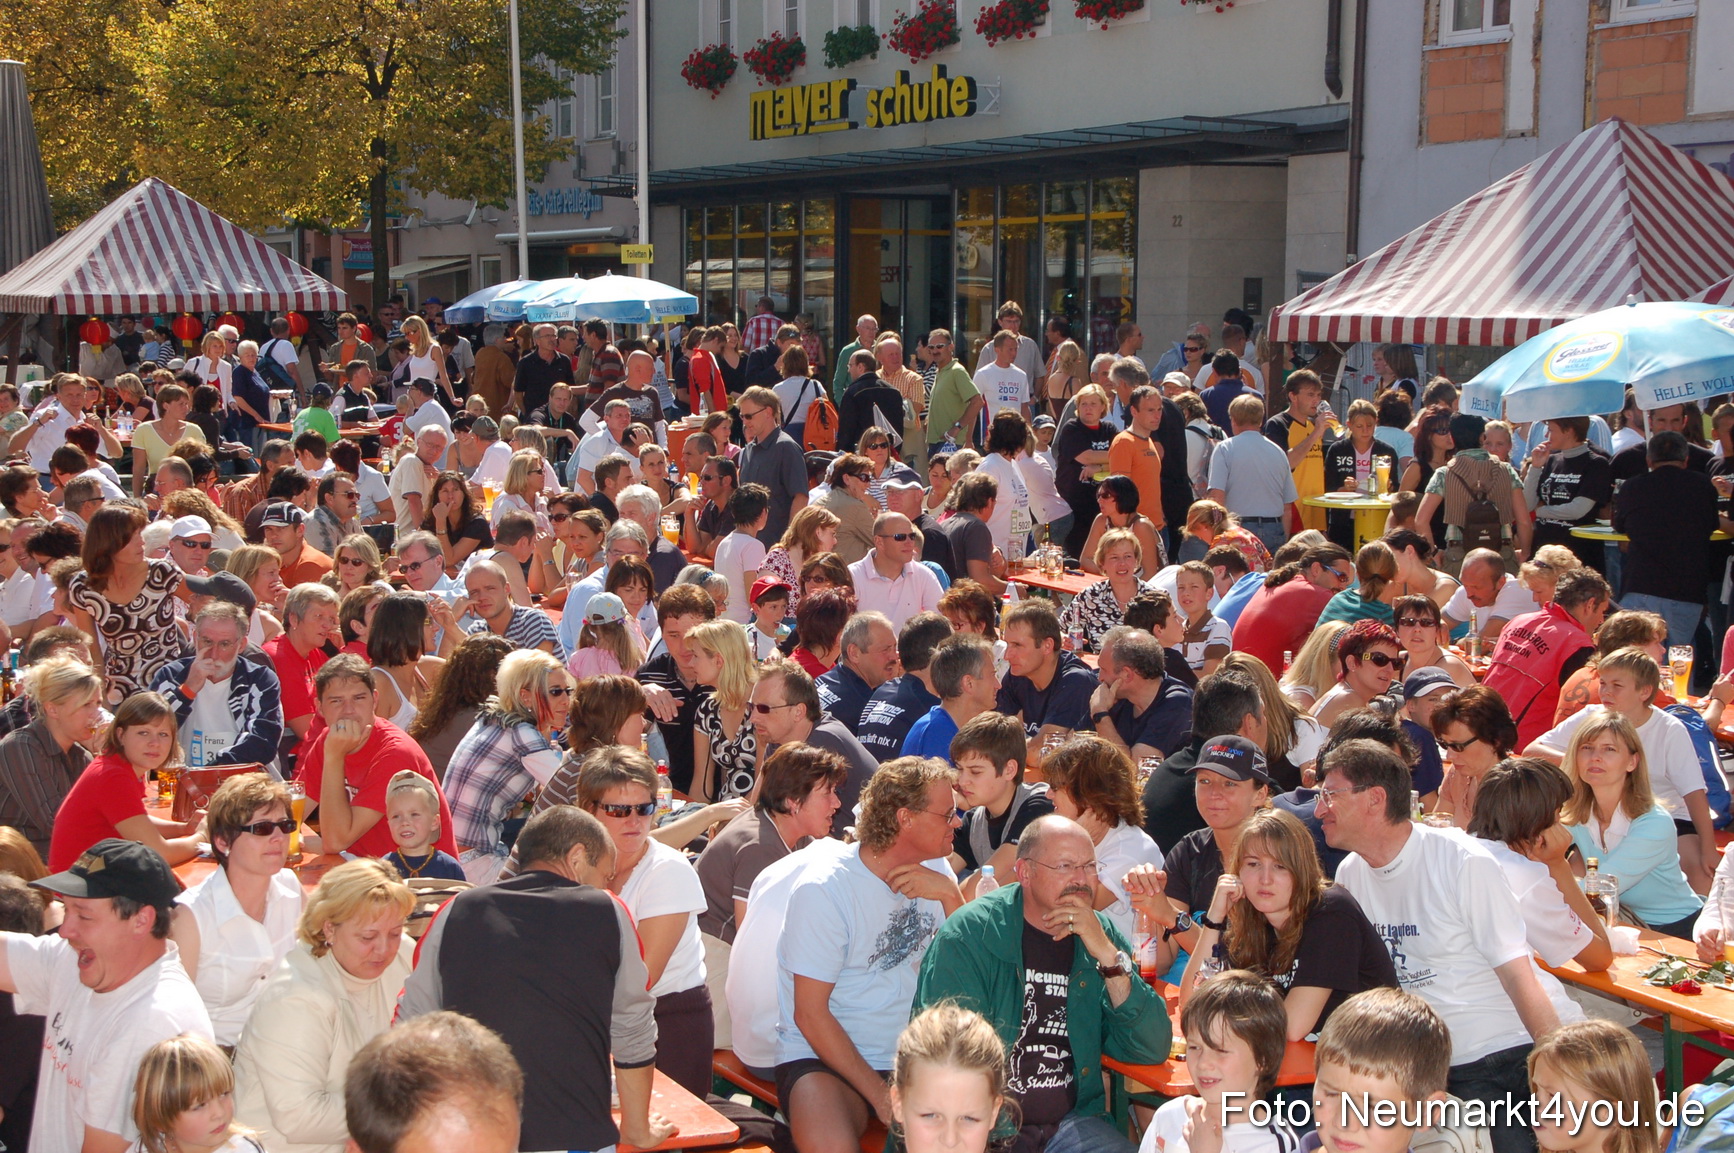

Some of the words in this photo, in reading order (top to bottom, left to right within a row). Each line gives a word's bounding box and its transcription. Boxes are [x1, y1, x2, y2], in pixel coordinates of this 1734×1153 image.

[749, 78, 856, 141] mayer
[866, 64, 975, 128] schuhe
[1172, 214, 1182, 227] 22
[626, 249, 647, 259] Toiletten
[998, 386, 1020, 394] 2007
[1653, 382, 1696, 402] HELLE
[1470, 396, 1489, 412] HELLE
[204, 735, 225, 745] Franz
